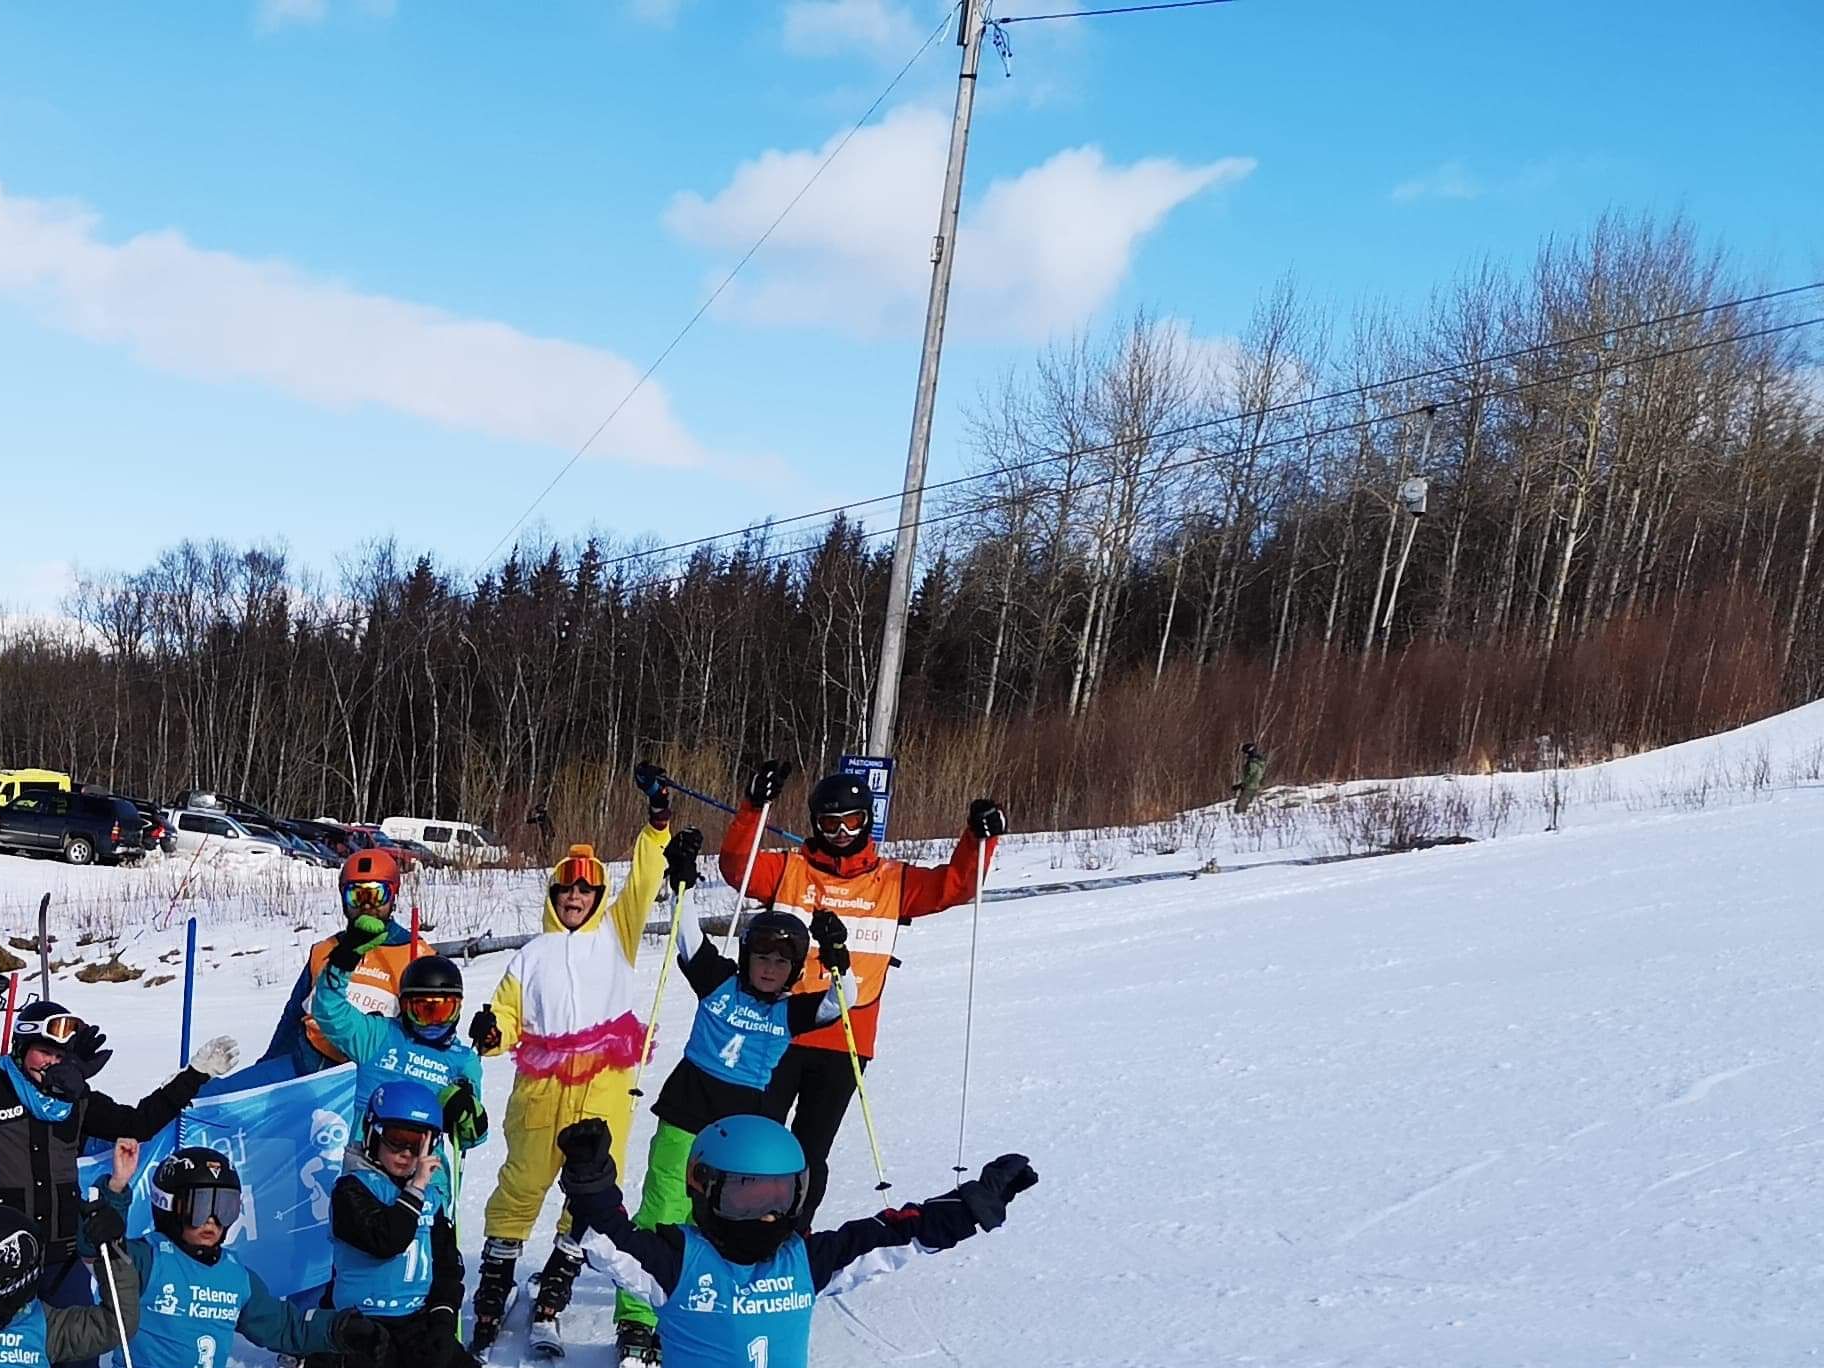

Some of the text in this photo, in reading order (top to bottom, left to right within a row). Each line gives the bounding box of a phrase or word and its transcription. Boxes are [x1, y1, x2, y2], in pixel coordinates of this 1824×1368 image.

[727, 1012, 785, 1036] Karusellen
[407, 1051, 449, 1074] Telenor
[719, 1033, 746, 1069] 4
[189, 1285, 239, 1304] Telenor
[732, 1292, 812, 1314] Karusellen
